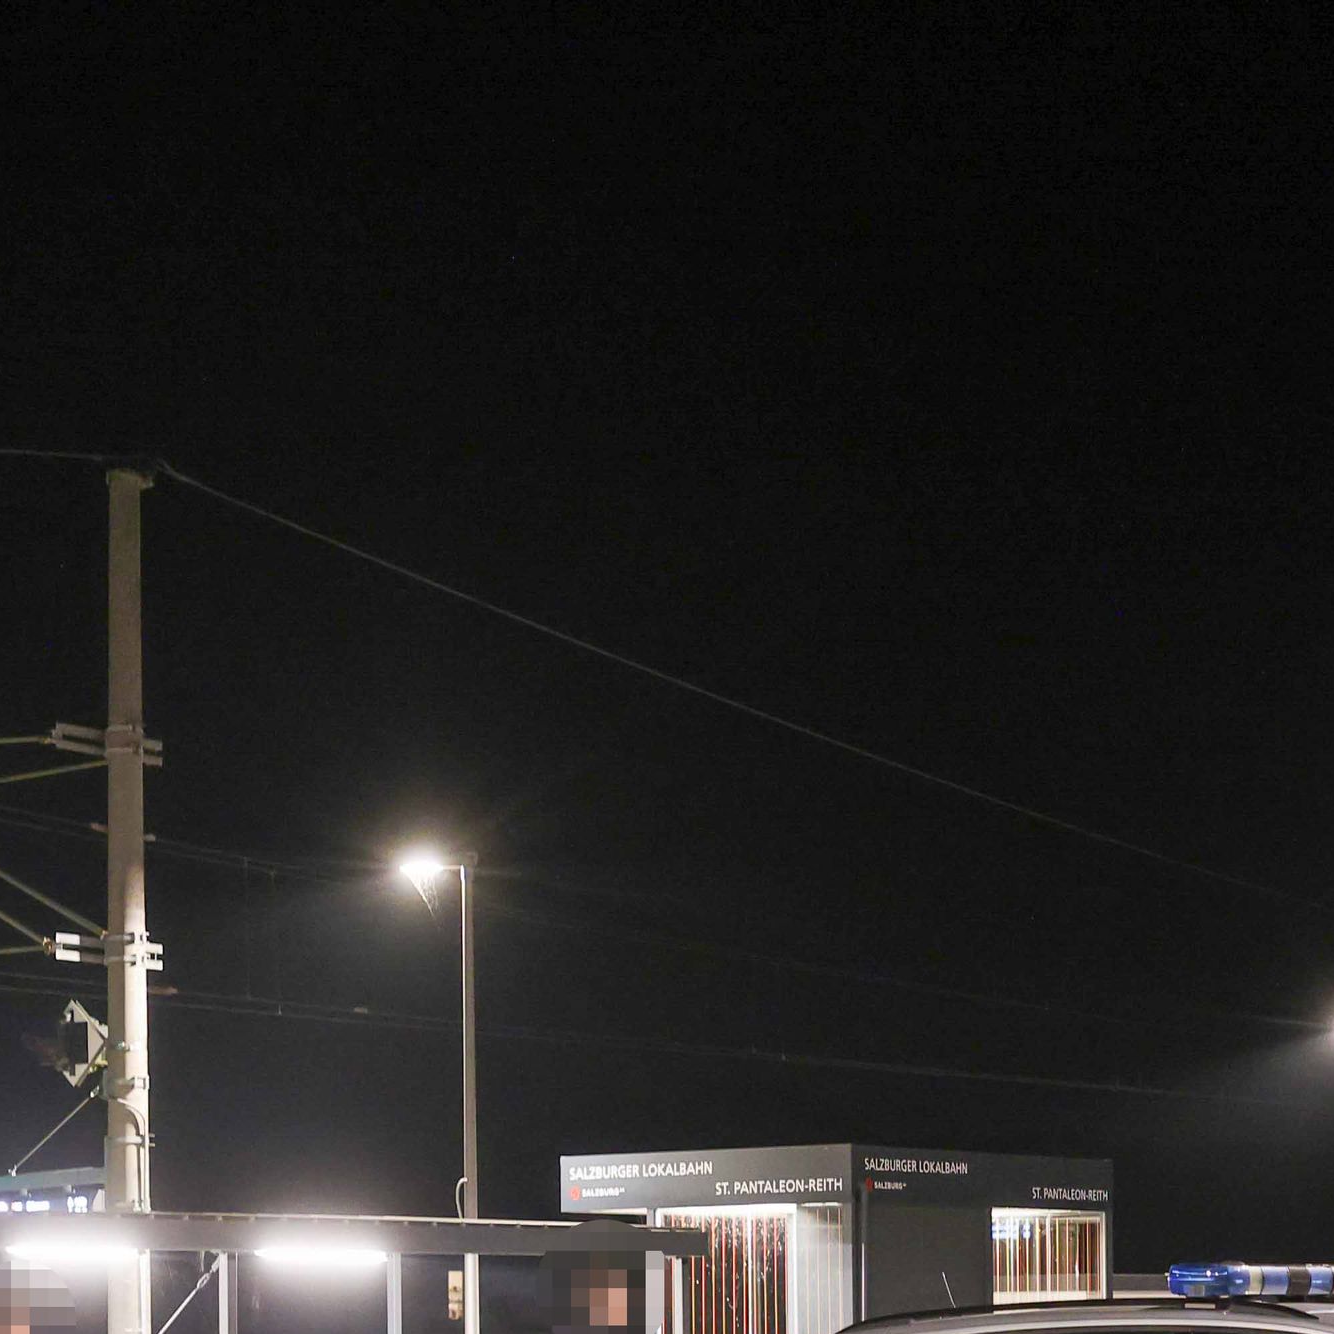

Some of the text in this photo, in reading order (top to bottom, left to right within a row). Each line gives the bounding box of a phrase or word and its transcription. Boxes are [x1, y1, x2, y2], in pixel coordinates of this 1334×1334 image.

[569, 1161, 713, 1181] SALZBURGER LOKALBAHN
[864, 1158, 968, 1174] SALZBURGER LOKALBAHN
[715, 1178, 843, 1195] ST. PANTALEON-REITH
[1032, 1187, 1109, 1201] ST. PANTALEON-REITH
